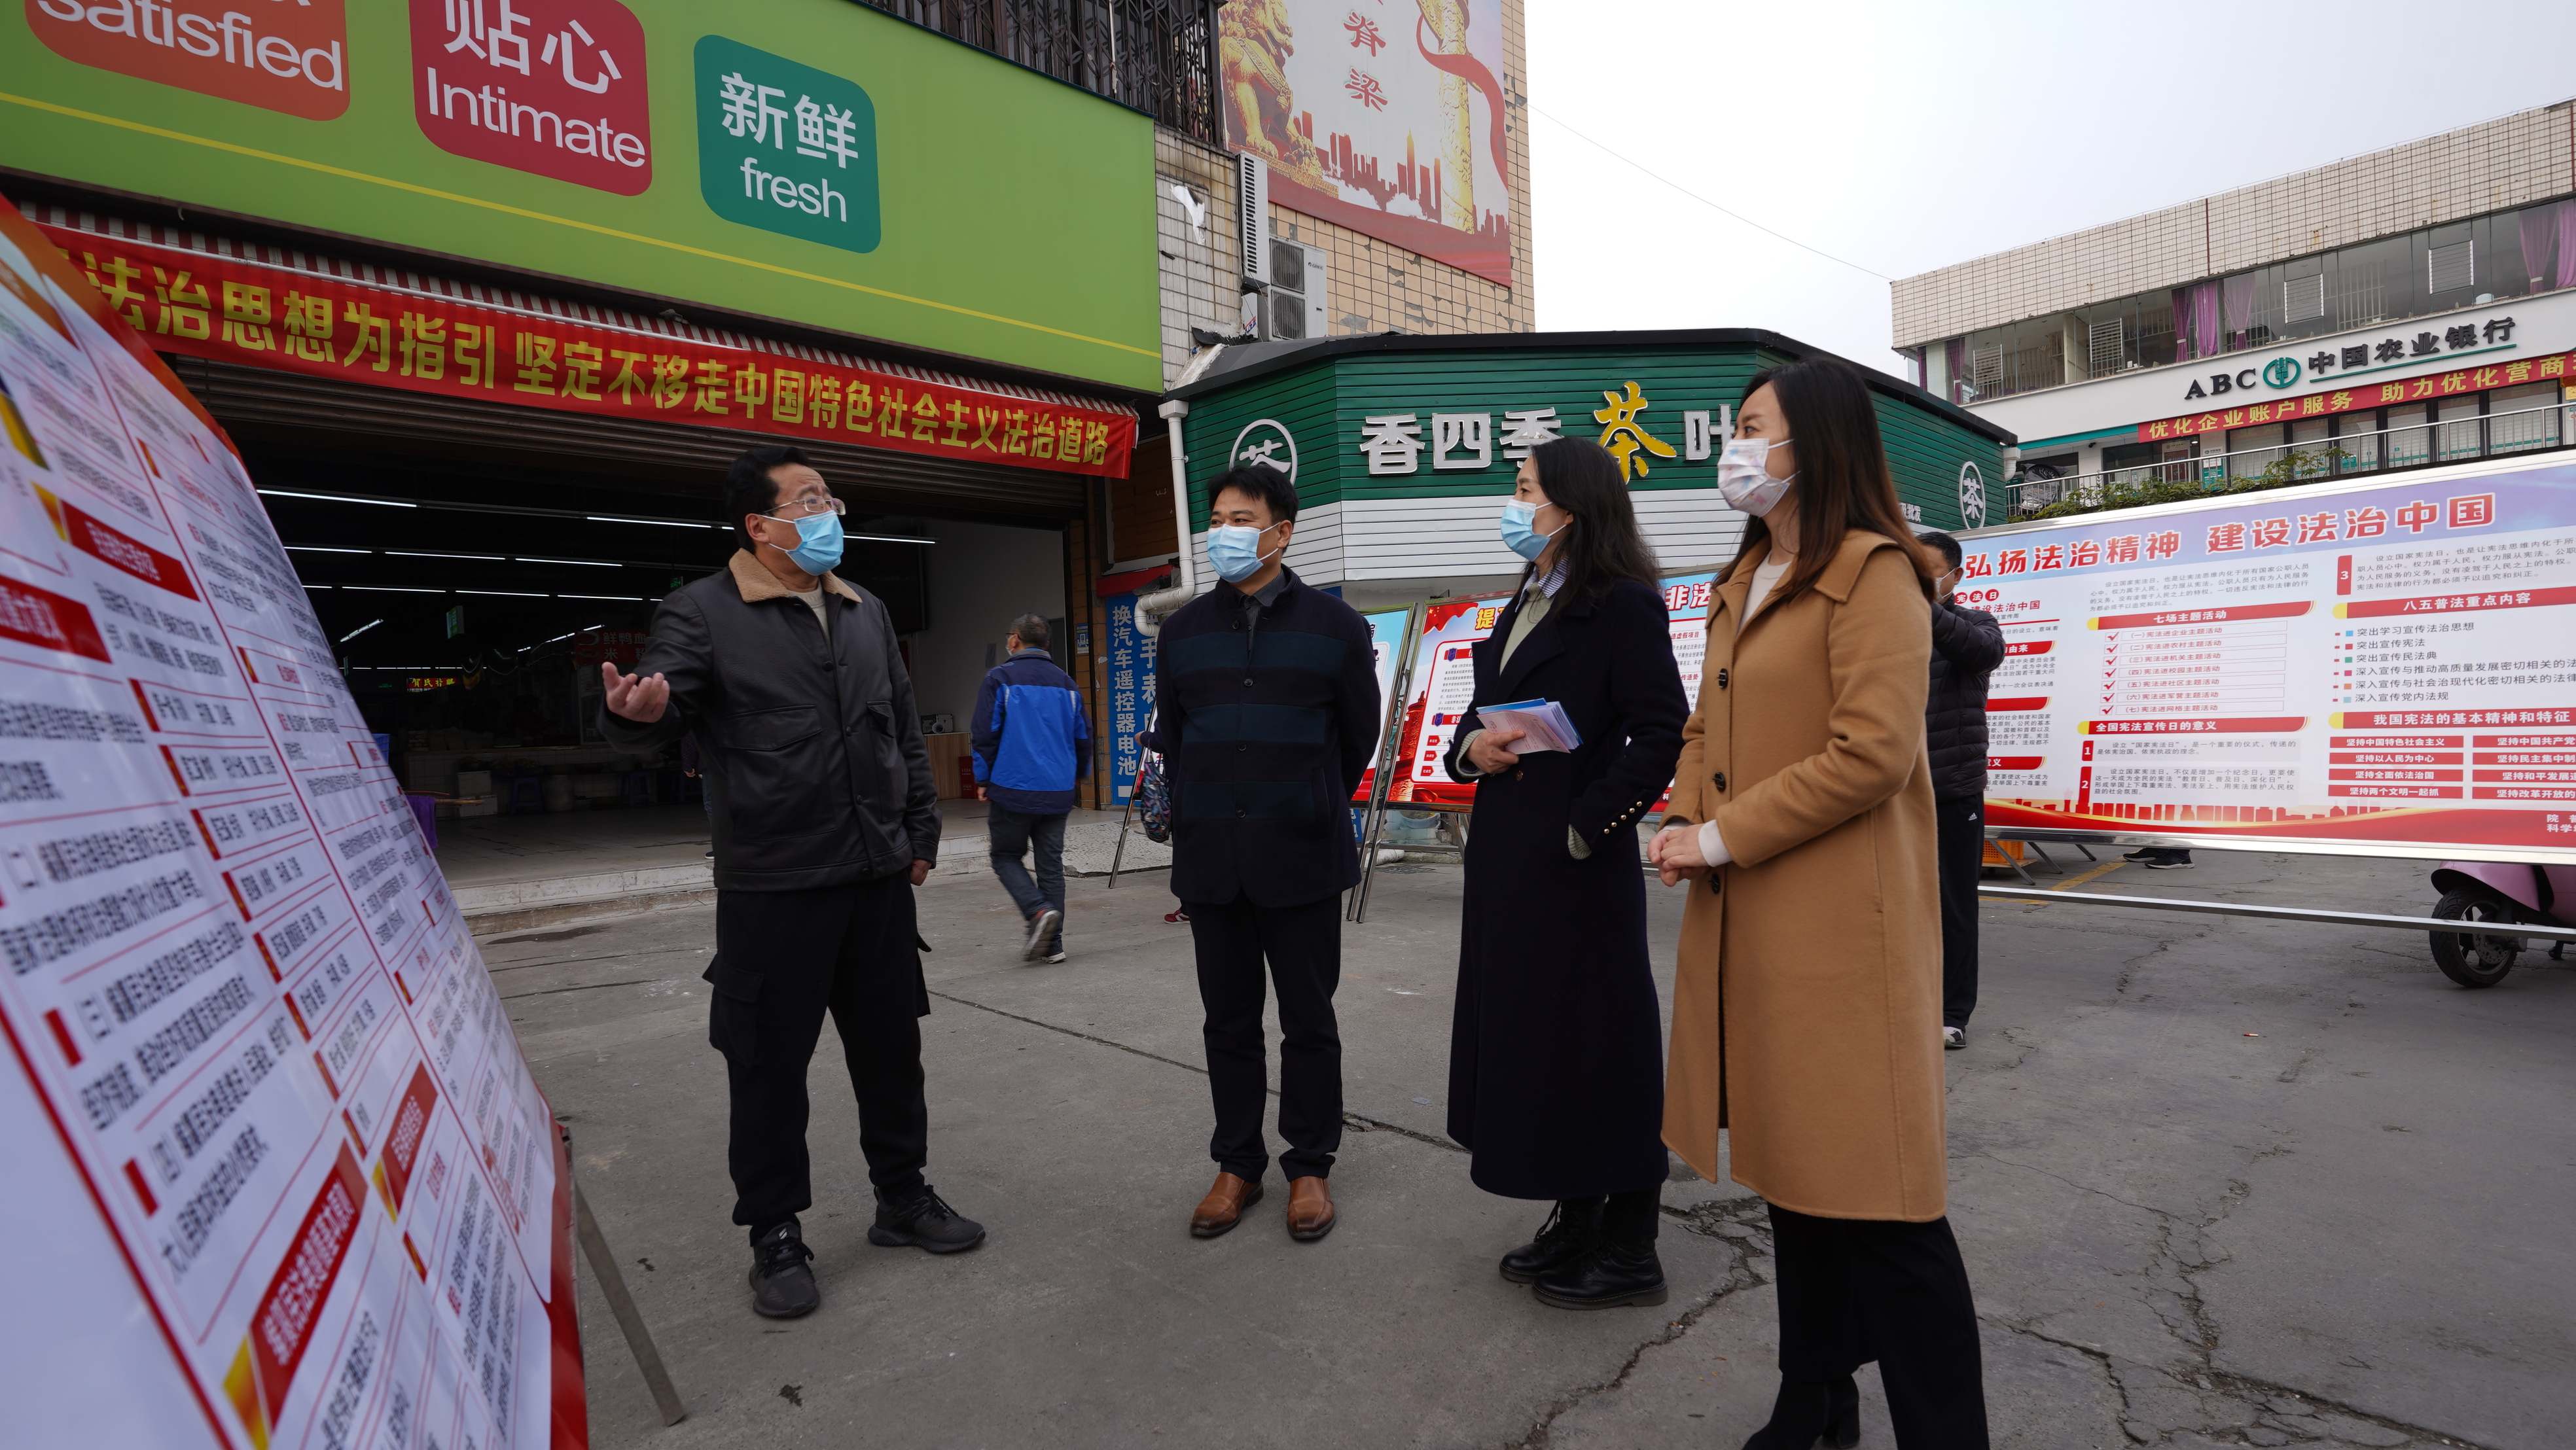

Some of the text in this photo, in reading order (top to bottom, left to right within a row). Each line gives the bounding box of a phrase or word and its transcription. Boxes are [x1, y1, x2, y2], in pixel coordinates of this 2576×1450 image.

[427, 66, 645, 168] Intimate
[720, 71, 859, 169] 新鲜
[740, 157, 847, 222] fresh
[56, 249, 495, 391] 法治思想为指引
[513, 331, 1109, 465] 坚定不移走中国特色社会主义法治道路
[2185, 317, 2516, 400] ABC 中国农业银行
[2149, 391, 2353, 439] 优化企业账户服务
[1963, 477, 1984, 520] 茶
[1965, 493, 2496, 579] 弘扬法治精神 建设法治中国
[2376, 537, 2576, 562] 设立国家宪法日，也是让宪法思维内化于所
[2340, 571, 2349, 580] 3
[2403, 592, 2531, 611] 八五普法重点内容
[2153, 610, 2227, 624] 七场主题活动
[2357, 622, 2475, 637] 突出学习宣传法治思想
[2356, 638, 2425, 650] 突出宣传宪法
[2356, 651, 2437, 663] 突出宣传民法典
[1112, 605, 1137, 777] 换汽车遥控器电池
[2355, 692, 2449, 703] 深入宣传党内法规
[2096, 720, 2217, 732] 全国宪法宣传日的意义
[2373, 711, 2571, 726] 我国宪法的基本精神和特征
[2346, 738, 2445, 747] 坚持中国特色社会主义
[2084, 747, 2091, 755] 1
[2355, 754, 2435, 763] 坚持以人民为中心
[2355, 771, 2435, 779] 坚持全面依法治国
[2081, 781, 2088, 789] 2
[2350, 787, 2439, 796] 坚持两个文明一起抓
